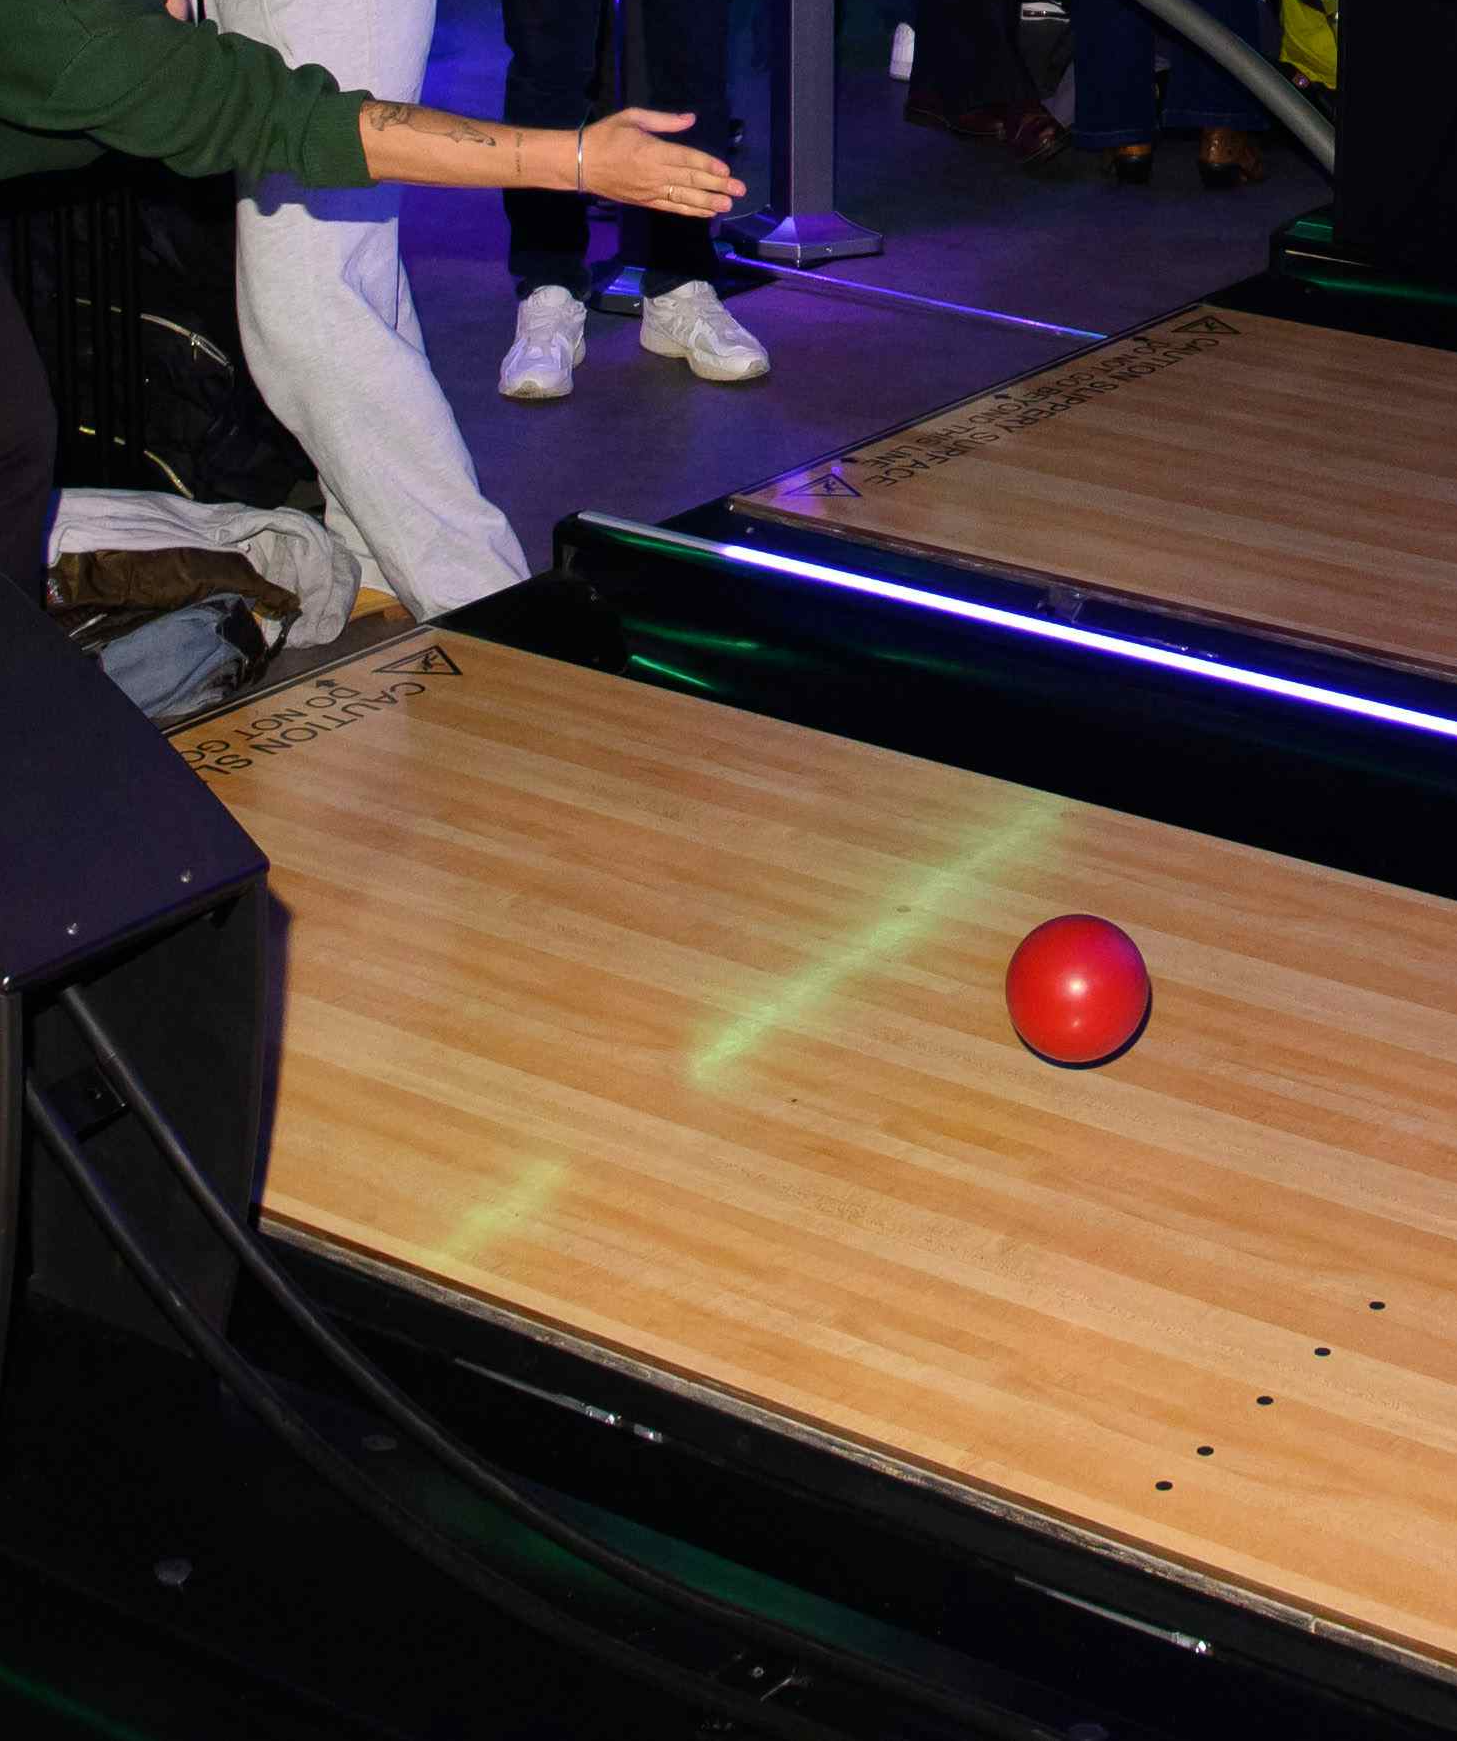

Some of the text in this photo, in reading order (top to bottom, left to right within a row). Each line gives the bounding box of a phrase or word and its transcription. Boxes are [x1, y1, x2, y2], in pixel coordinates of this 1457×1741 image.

[1132, 340, 1171, 355] DO
[1056, 372, 1095, 388] GO
[862, 337, 1219, 487] CAUTION SLIPPERY SURFACE
[306, 686, 362, 709] DO
[233, 708, 309, 742] NOT
[249, 682, 426, 755] CAUTION
